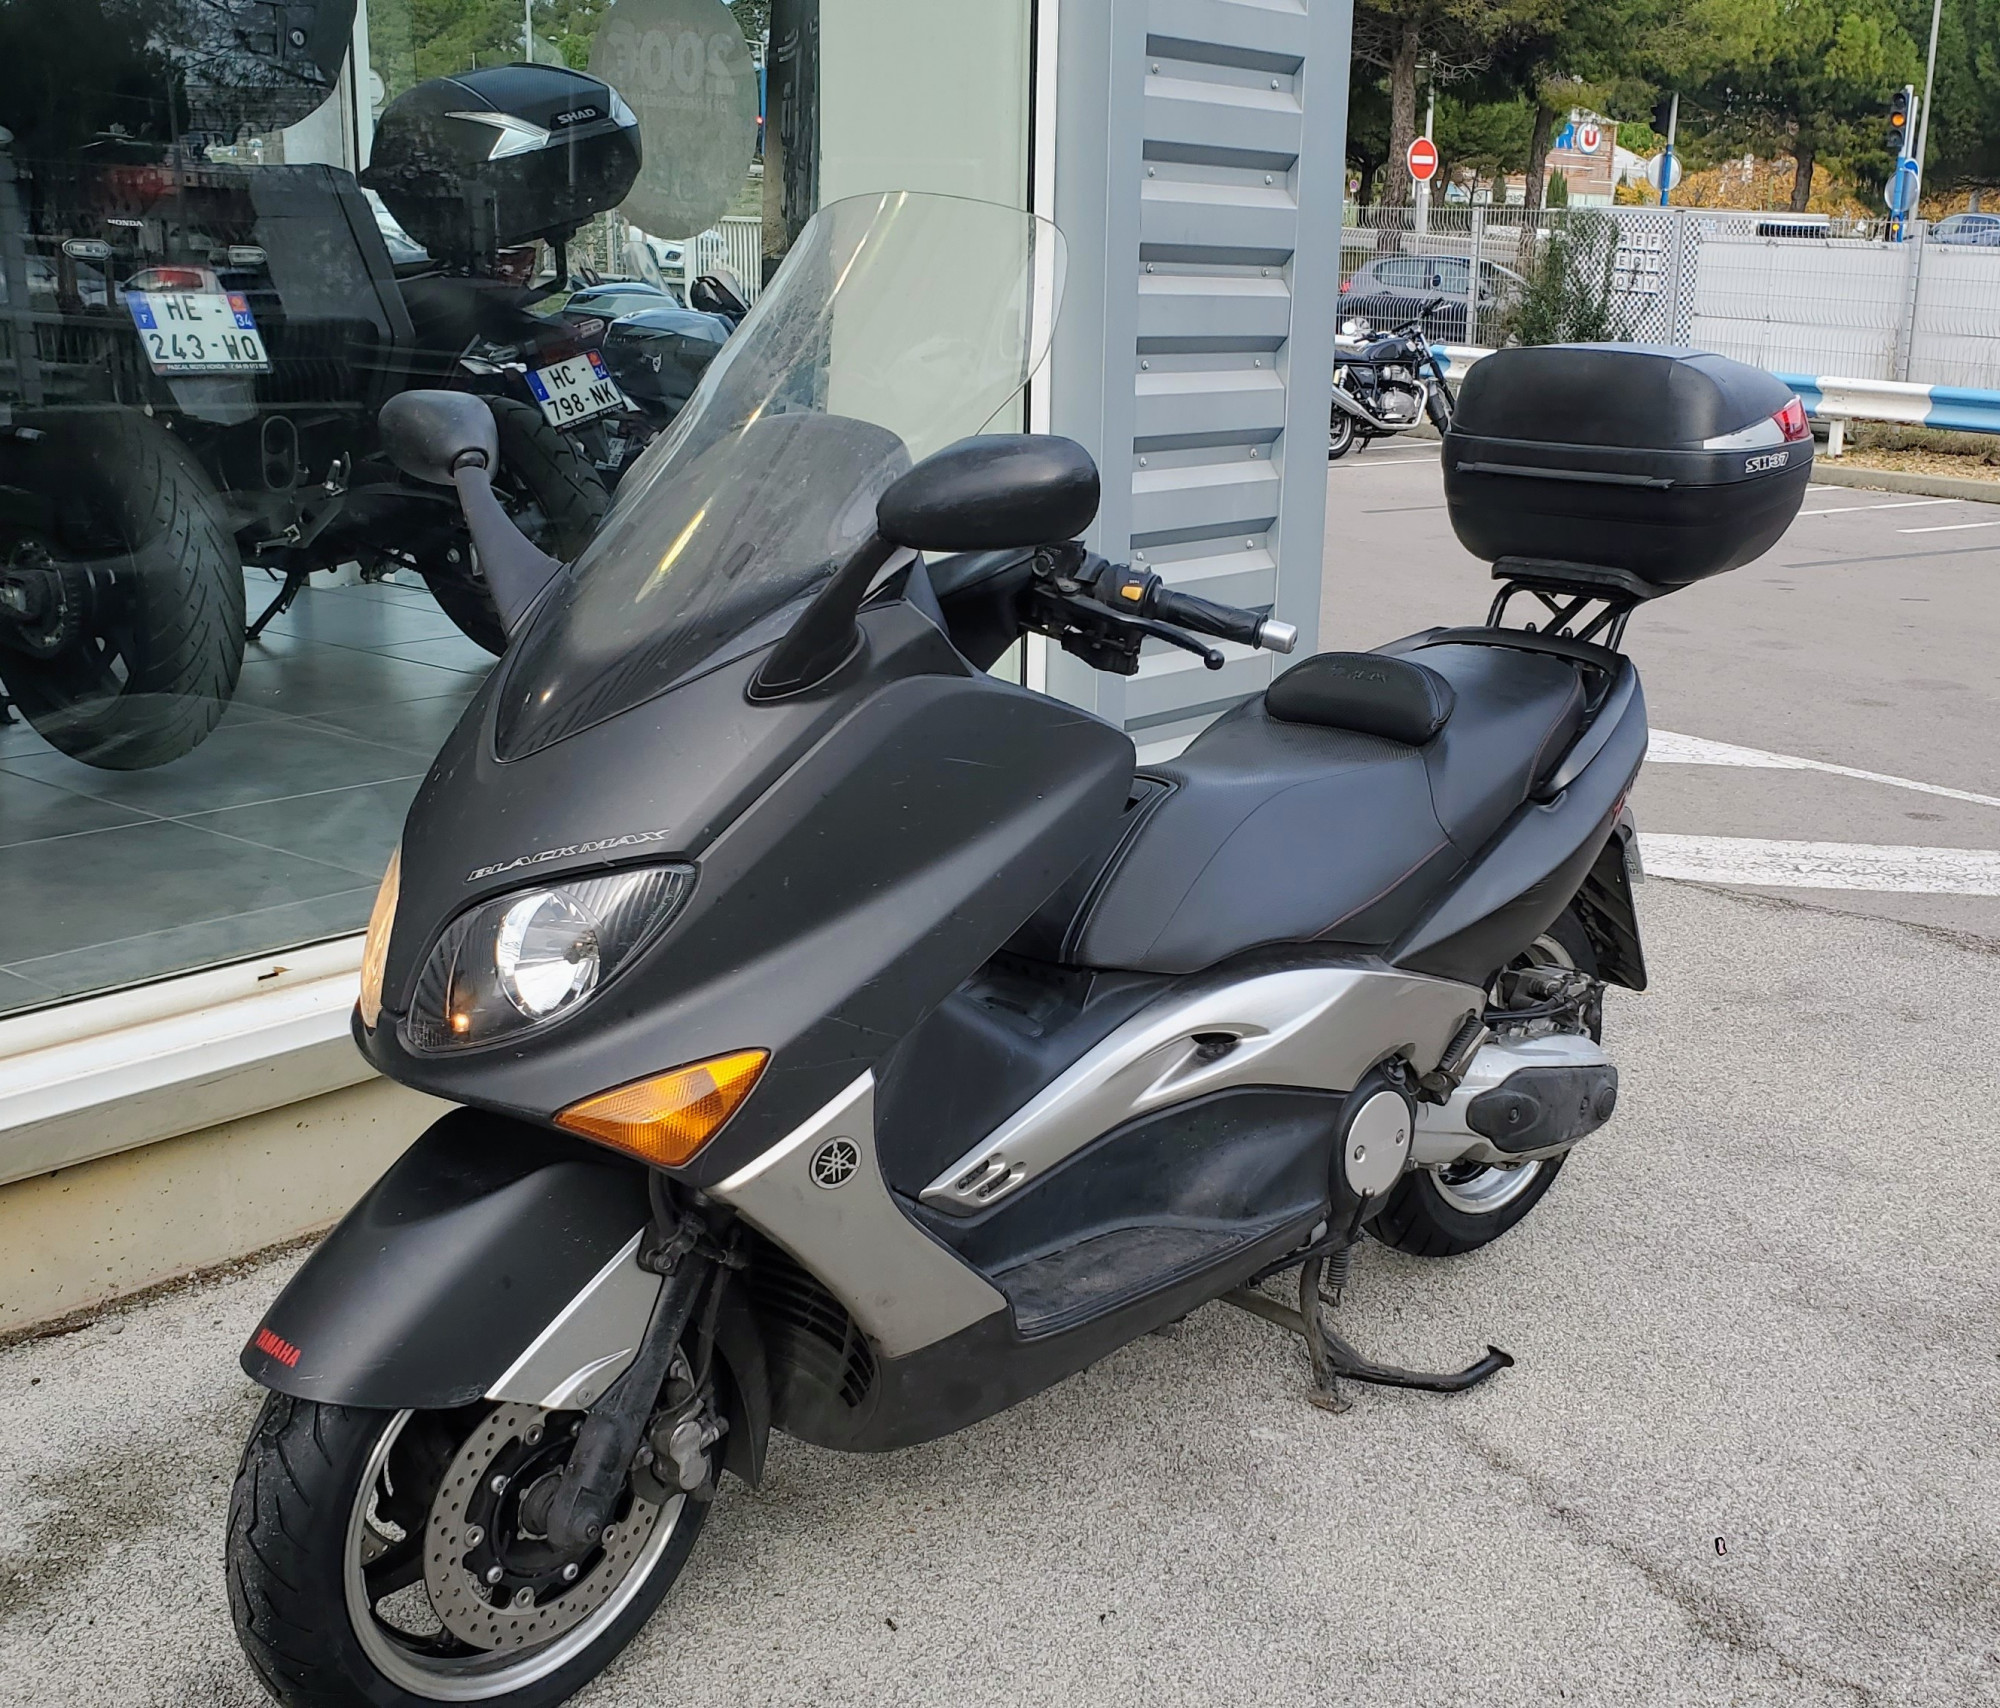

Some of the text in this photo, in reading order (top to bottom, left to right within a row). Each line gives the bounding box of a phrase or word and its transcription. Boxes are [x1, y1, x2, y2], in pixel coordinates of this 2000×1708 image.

[557, 108, 596, 124] SHAD
[107, 219, 144, 227] HONDA
[235, 314, 253, 327] 34
[547, 382, 617, 421] 798-NK
[1745, 452, 1789, 473] SH37
[255, 1328, 301, 1368] YAMAHA
